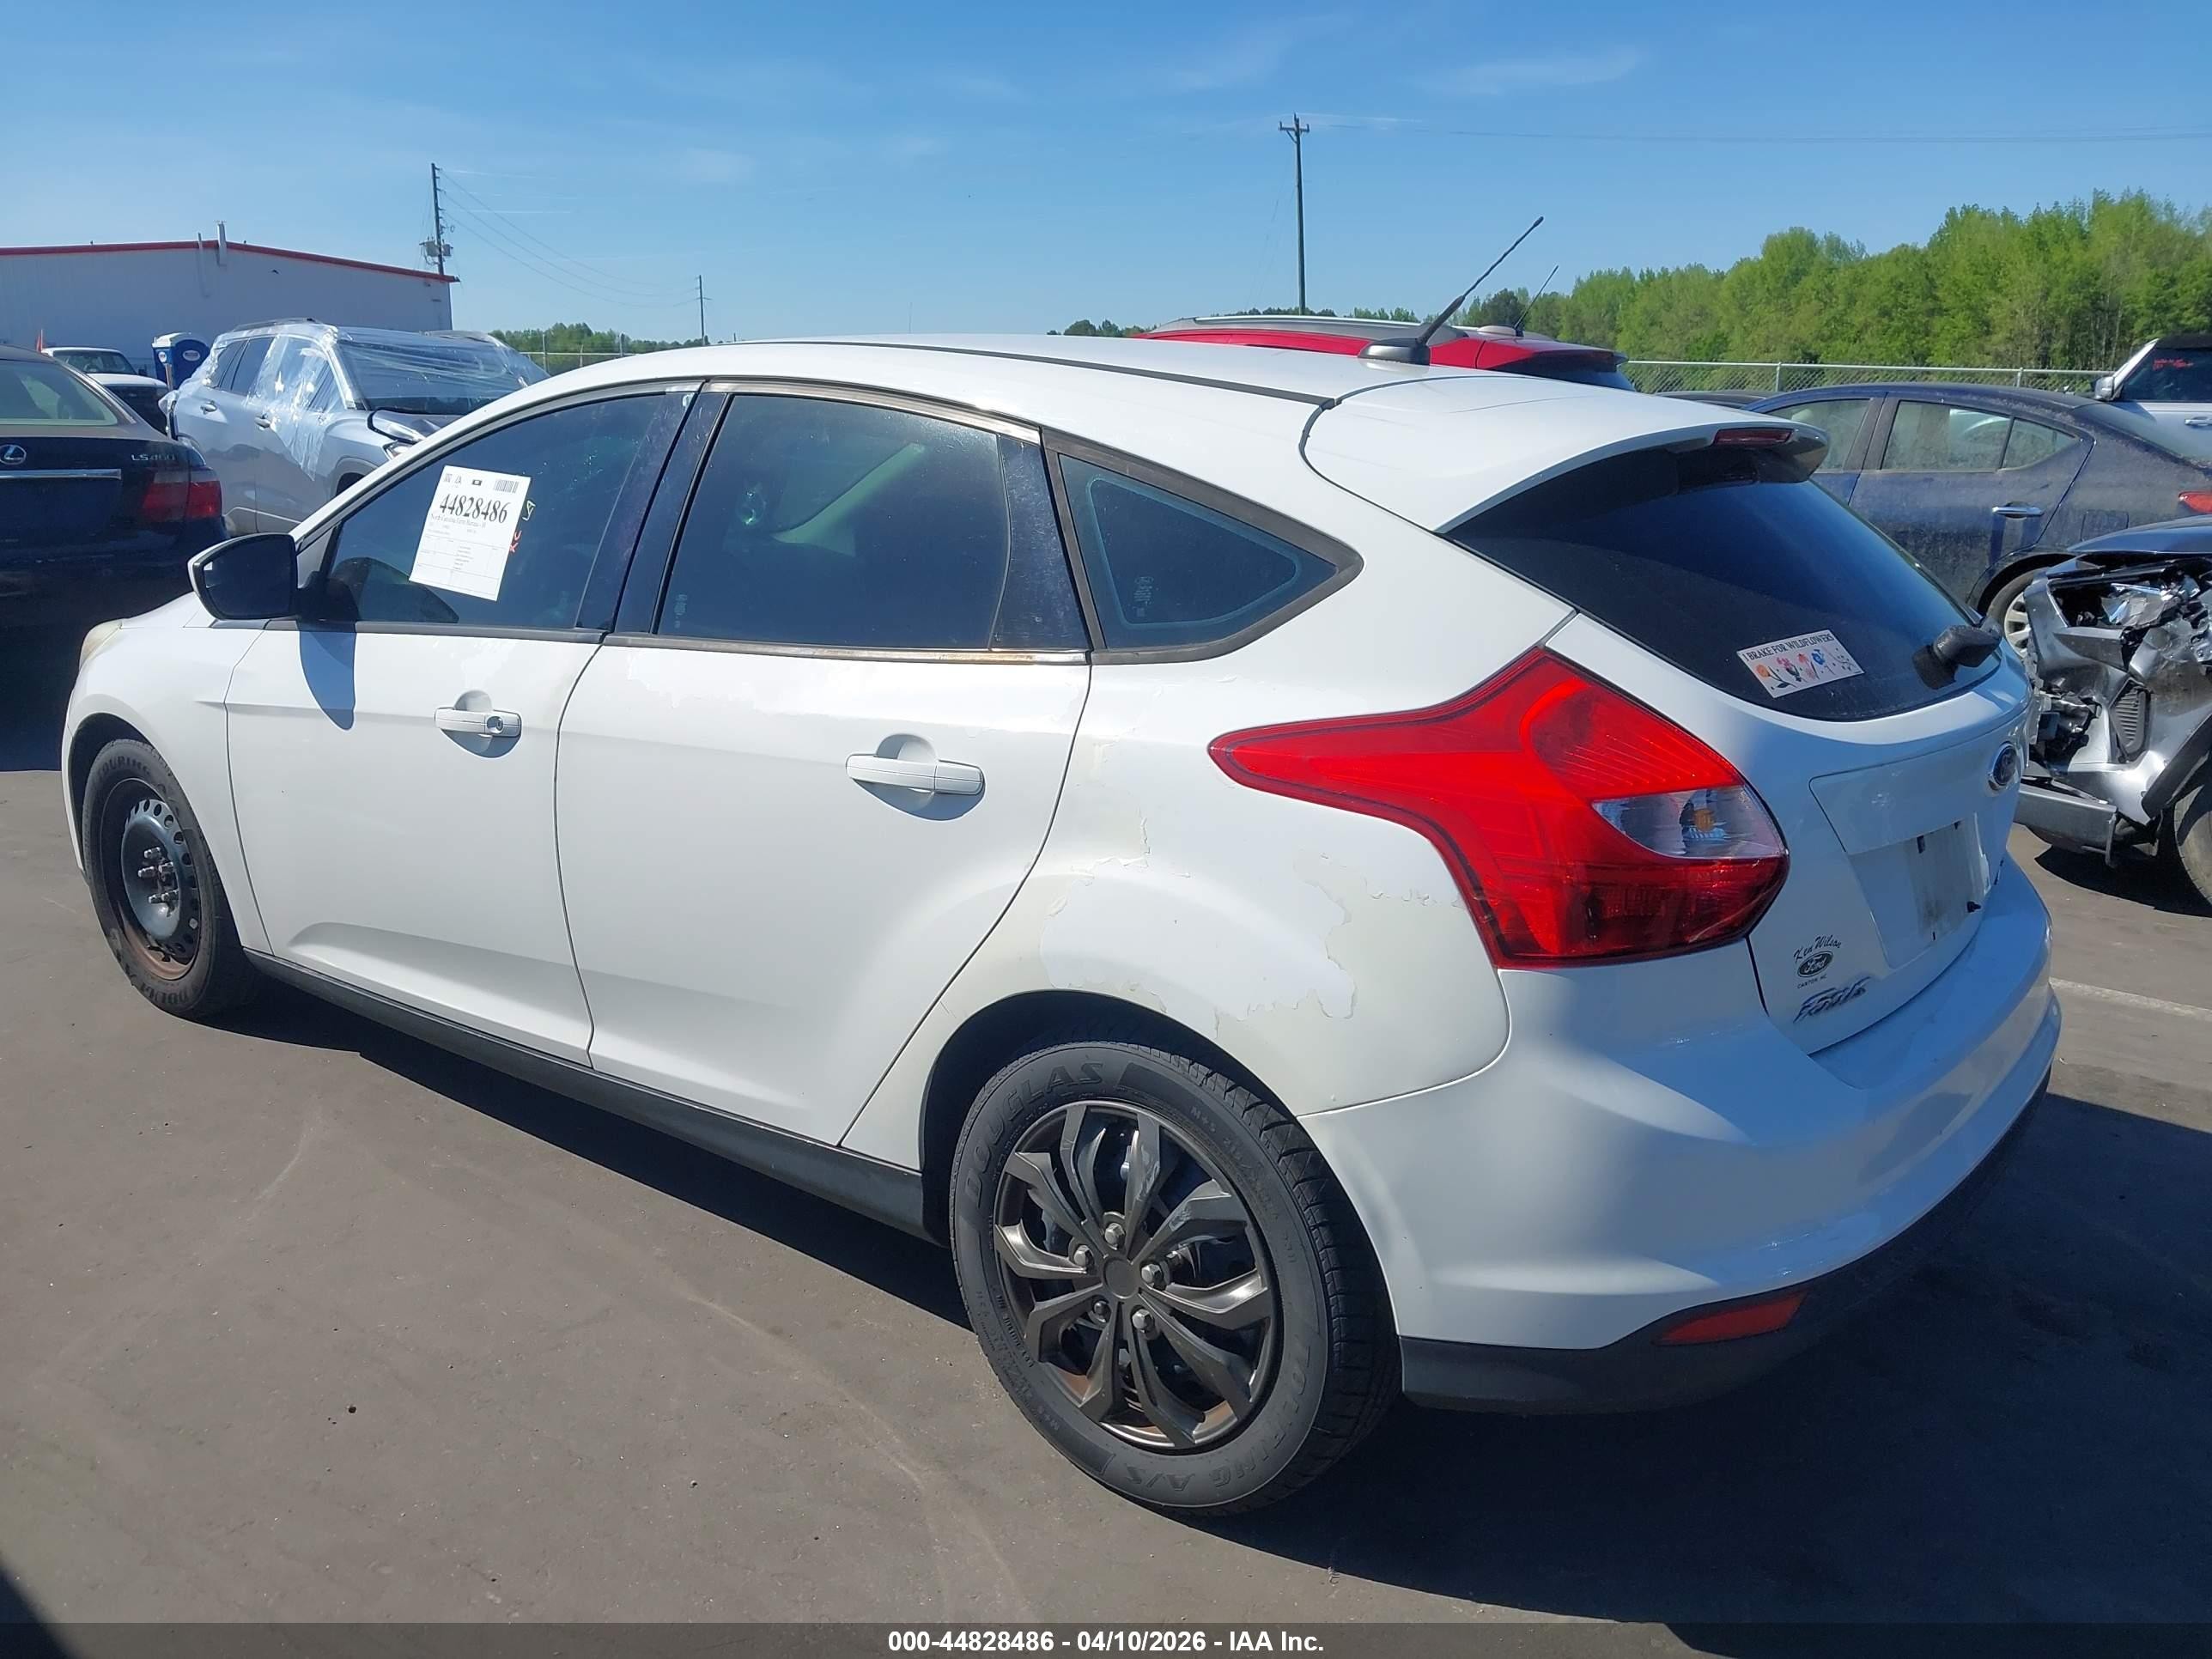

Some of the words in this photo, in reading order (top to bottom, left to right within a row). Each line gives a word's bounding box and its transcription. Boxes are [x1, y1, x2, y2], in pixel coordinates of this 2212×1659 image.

[439, 493, 512, 524] 44828486
[1741, 653, 1749, 662] I
[1748, 647, 1772, 660] BRAKE
[1772, 643, 1789, 655] FOR
[1788, 633, 1836, 649] WILDFLOWERS
[1793, 945, 1814, 963] Ken
[1814, 934, 1842, 950] Wilson
[1803, 954, 1827, 974] Ford
[964, 1060, 1104, 1209] DOUGLAS
